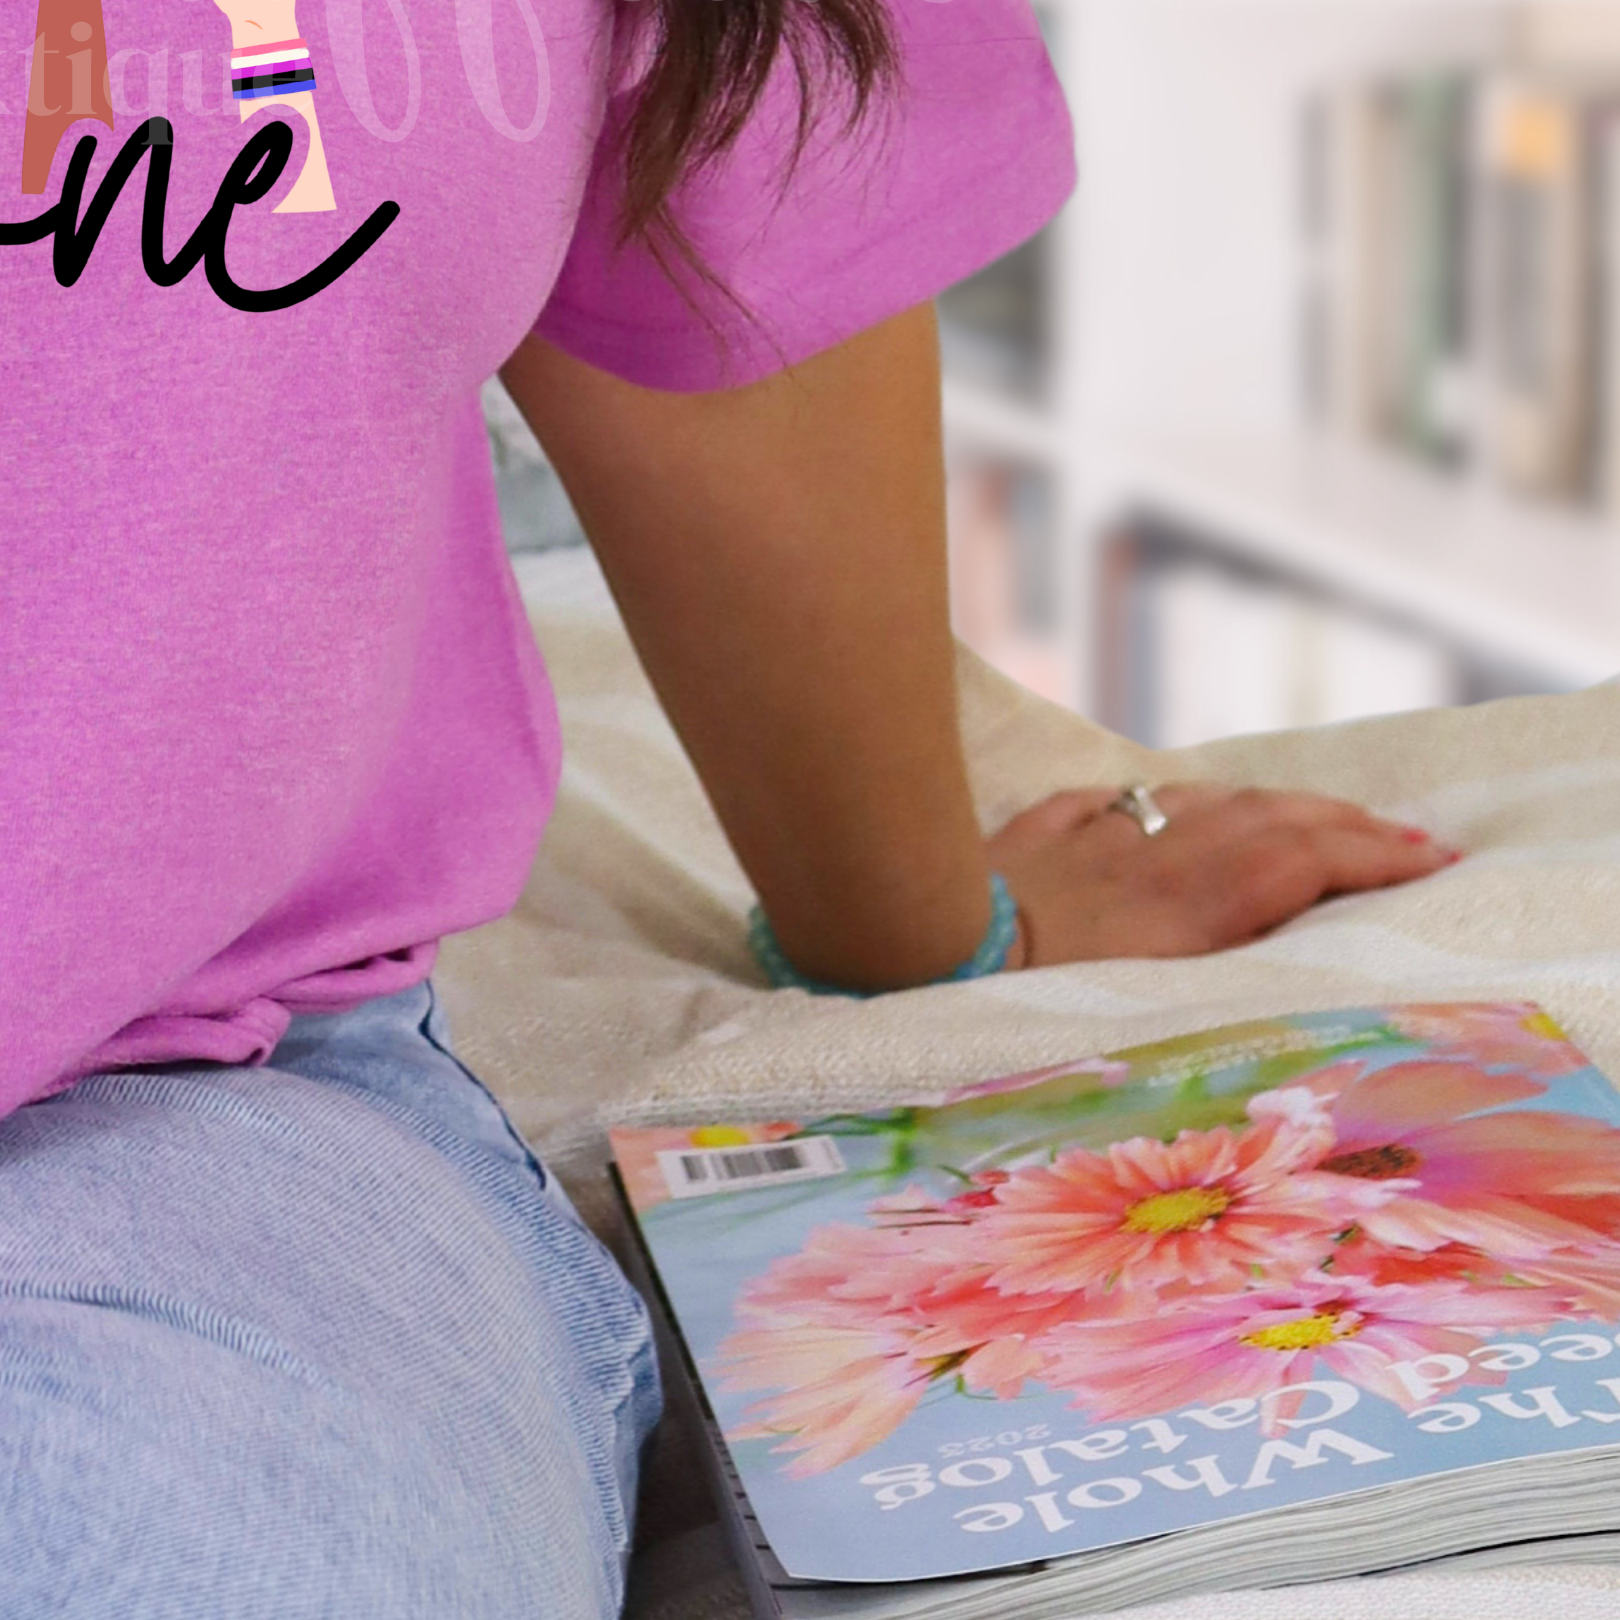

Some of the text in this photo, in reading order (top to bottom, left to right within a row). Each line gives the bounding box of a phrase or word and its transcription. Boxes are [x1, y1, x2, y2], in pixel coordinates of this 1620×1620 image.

[858, 1331, 1620, 1512] eed Catalog
[952, 1427, 1395, 1534] Whole
